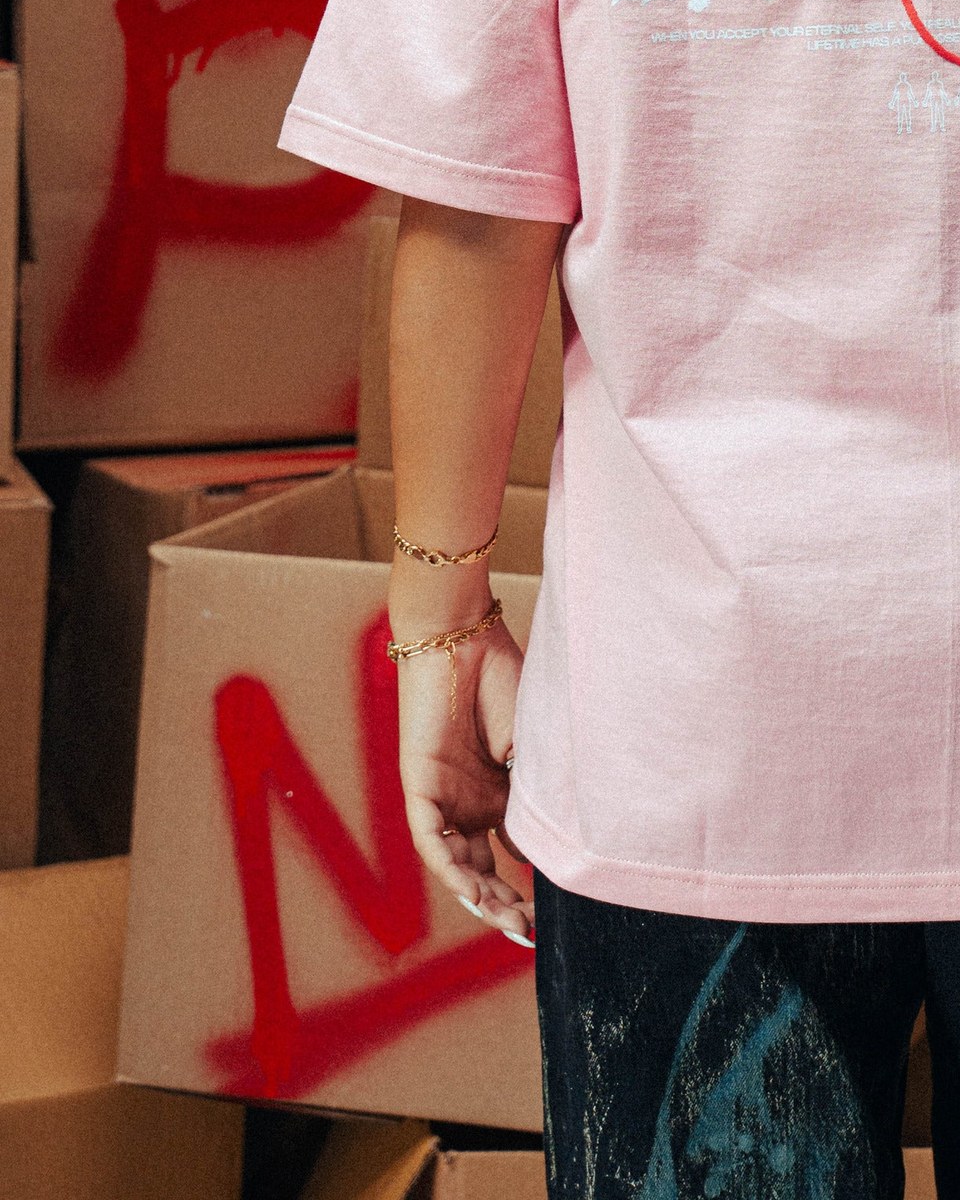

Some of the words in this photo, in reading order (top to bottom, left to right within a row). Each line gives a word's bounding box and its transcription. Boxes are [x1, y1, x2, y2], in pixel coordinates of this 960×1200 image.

[690, 29, 716, 40] YOU
[717, 27, 768, 39] ACCEPT
[770, 25, 804, 38] YOUR
[805, 23, 863, 36] ETERNAL
[862, 36, 890, 48] HAS
[891, 37, 901, 46] A
